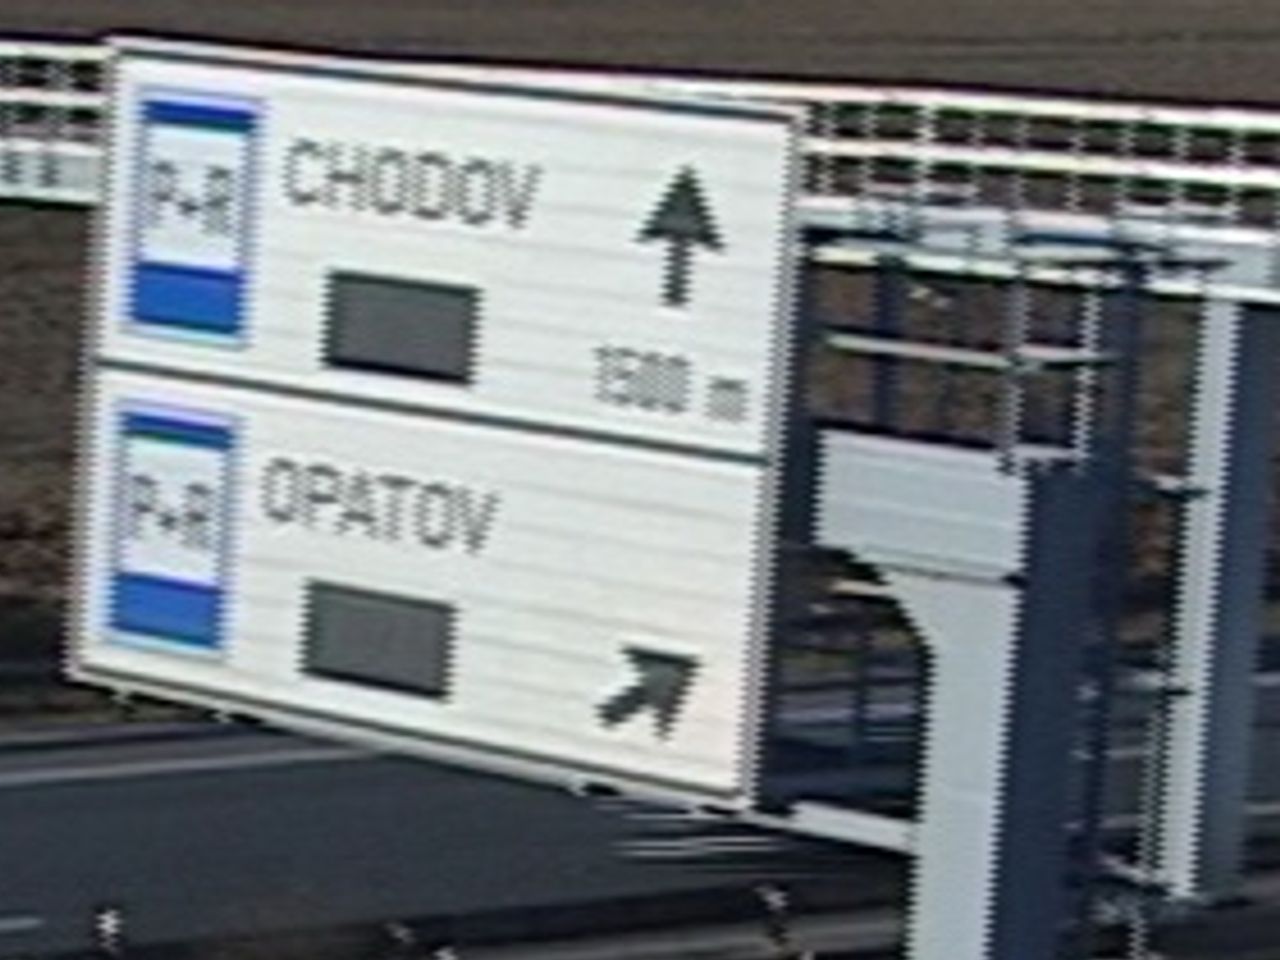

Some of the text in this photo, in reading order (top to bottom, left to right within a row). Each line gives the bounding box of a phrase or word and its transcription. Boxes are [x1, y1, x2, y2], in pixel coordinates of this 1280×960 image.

[282, 138, 545, 230] CHODOV
[705, 378, 750, 421] m
[260, 456, 501, 555] OPATOV
